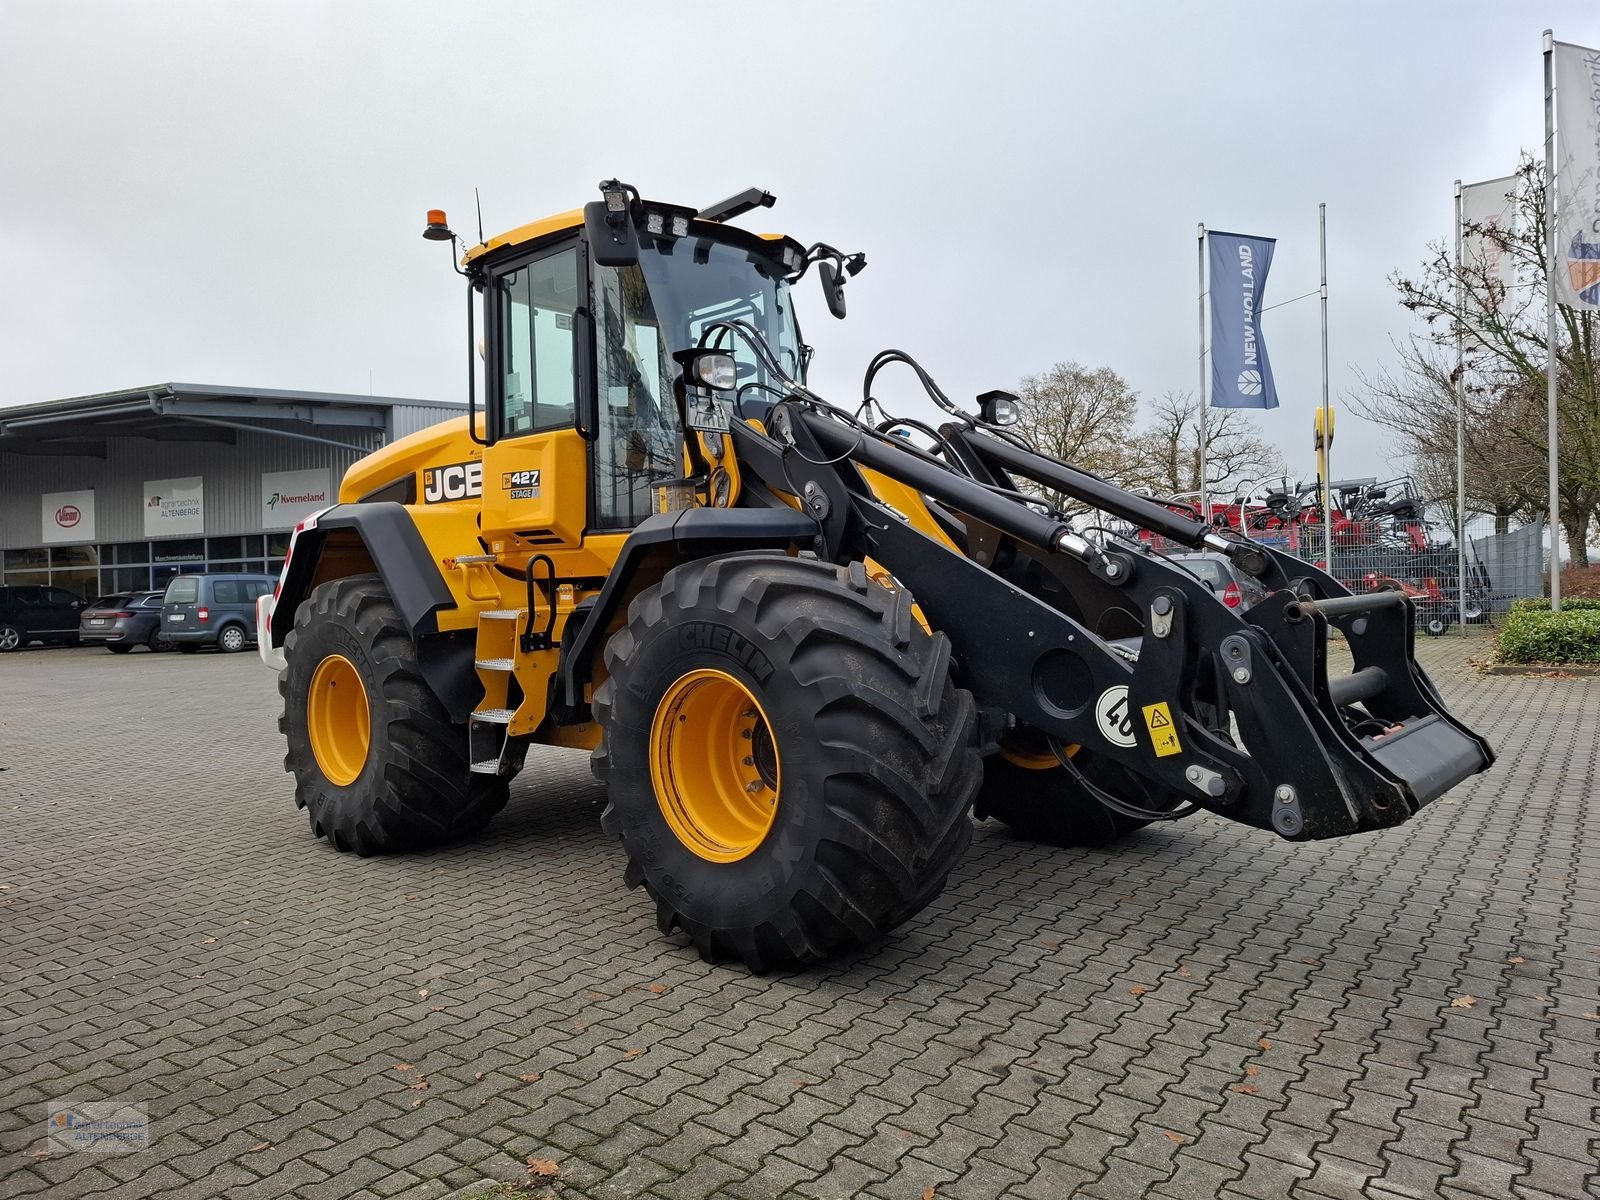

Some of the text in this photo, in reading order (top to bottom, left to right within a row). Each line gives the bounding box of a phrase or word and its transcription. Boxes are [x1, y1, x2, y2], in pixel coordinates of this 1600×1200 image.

[1238, 245, 1257, 365] NEW HOLLAND
[511, 470, 539, 485] 427
[280, 491, 325, 504] Kverneland
[511, 489, 532, 499] STAGE
[161, 497, 200, 509] agrartechnik
[161, 507, 200, 518] ALTENBERGE
[660, 623, 775, 682] ICHELIN
